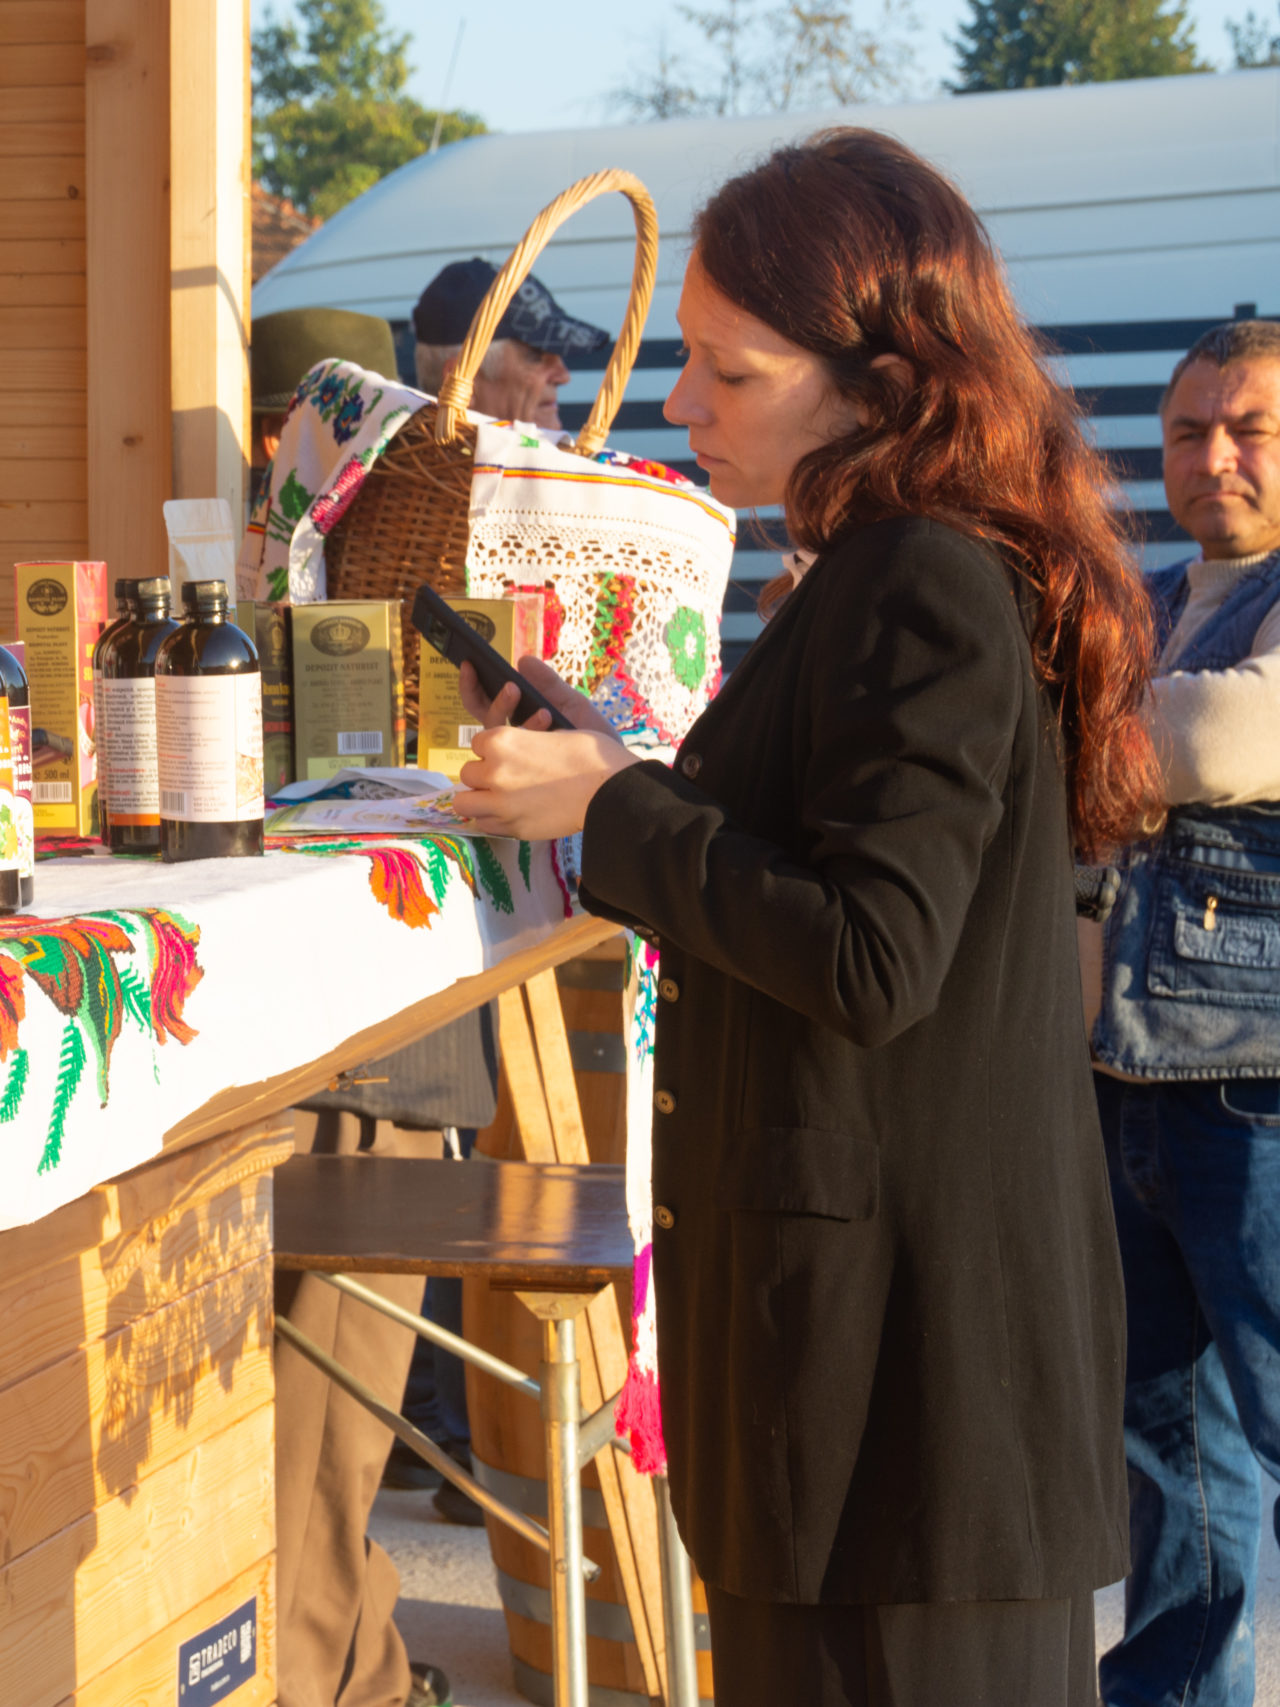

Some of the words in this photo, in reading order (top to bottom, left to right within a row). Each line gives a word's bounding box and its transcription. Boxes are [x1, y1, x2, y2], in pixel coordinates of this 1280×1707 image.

[305, 664, 338, 672] DEPOZIT
[44, 770, 58, 779] 500
[60, 769, 69, 779] ml
